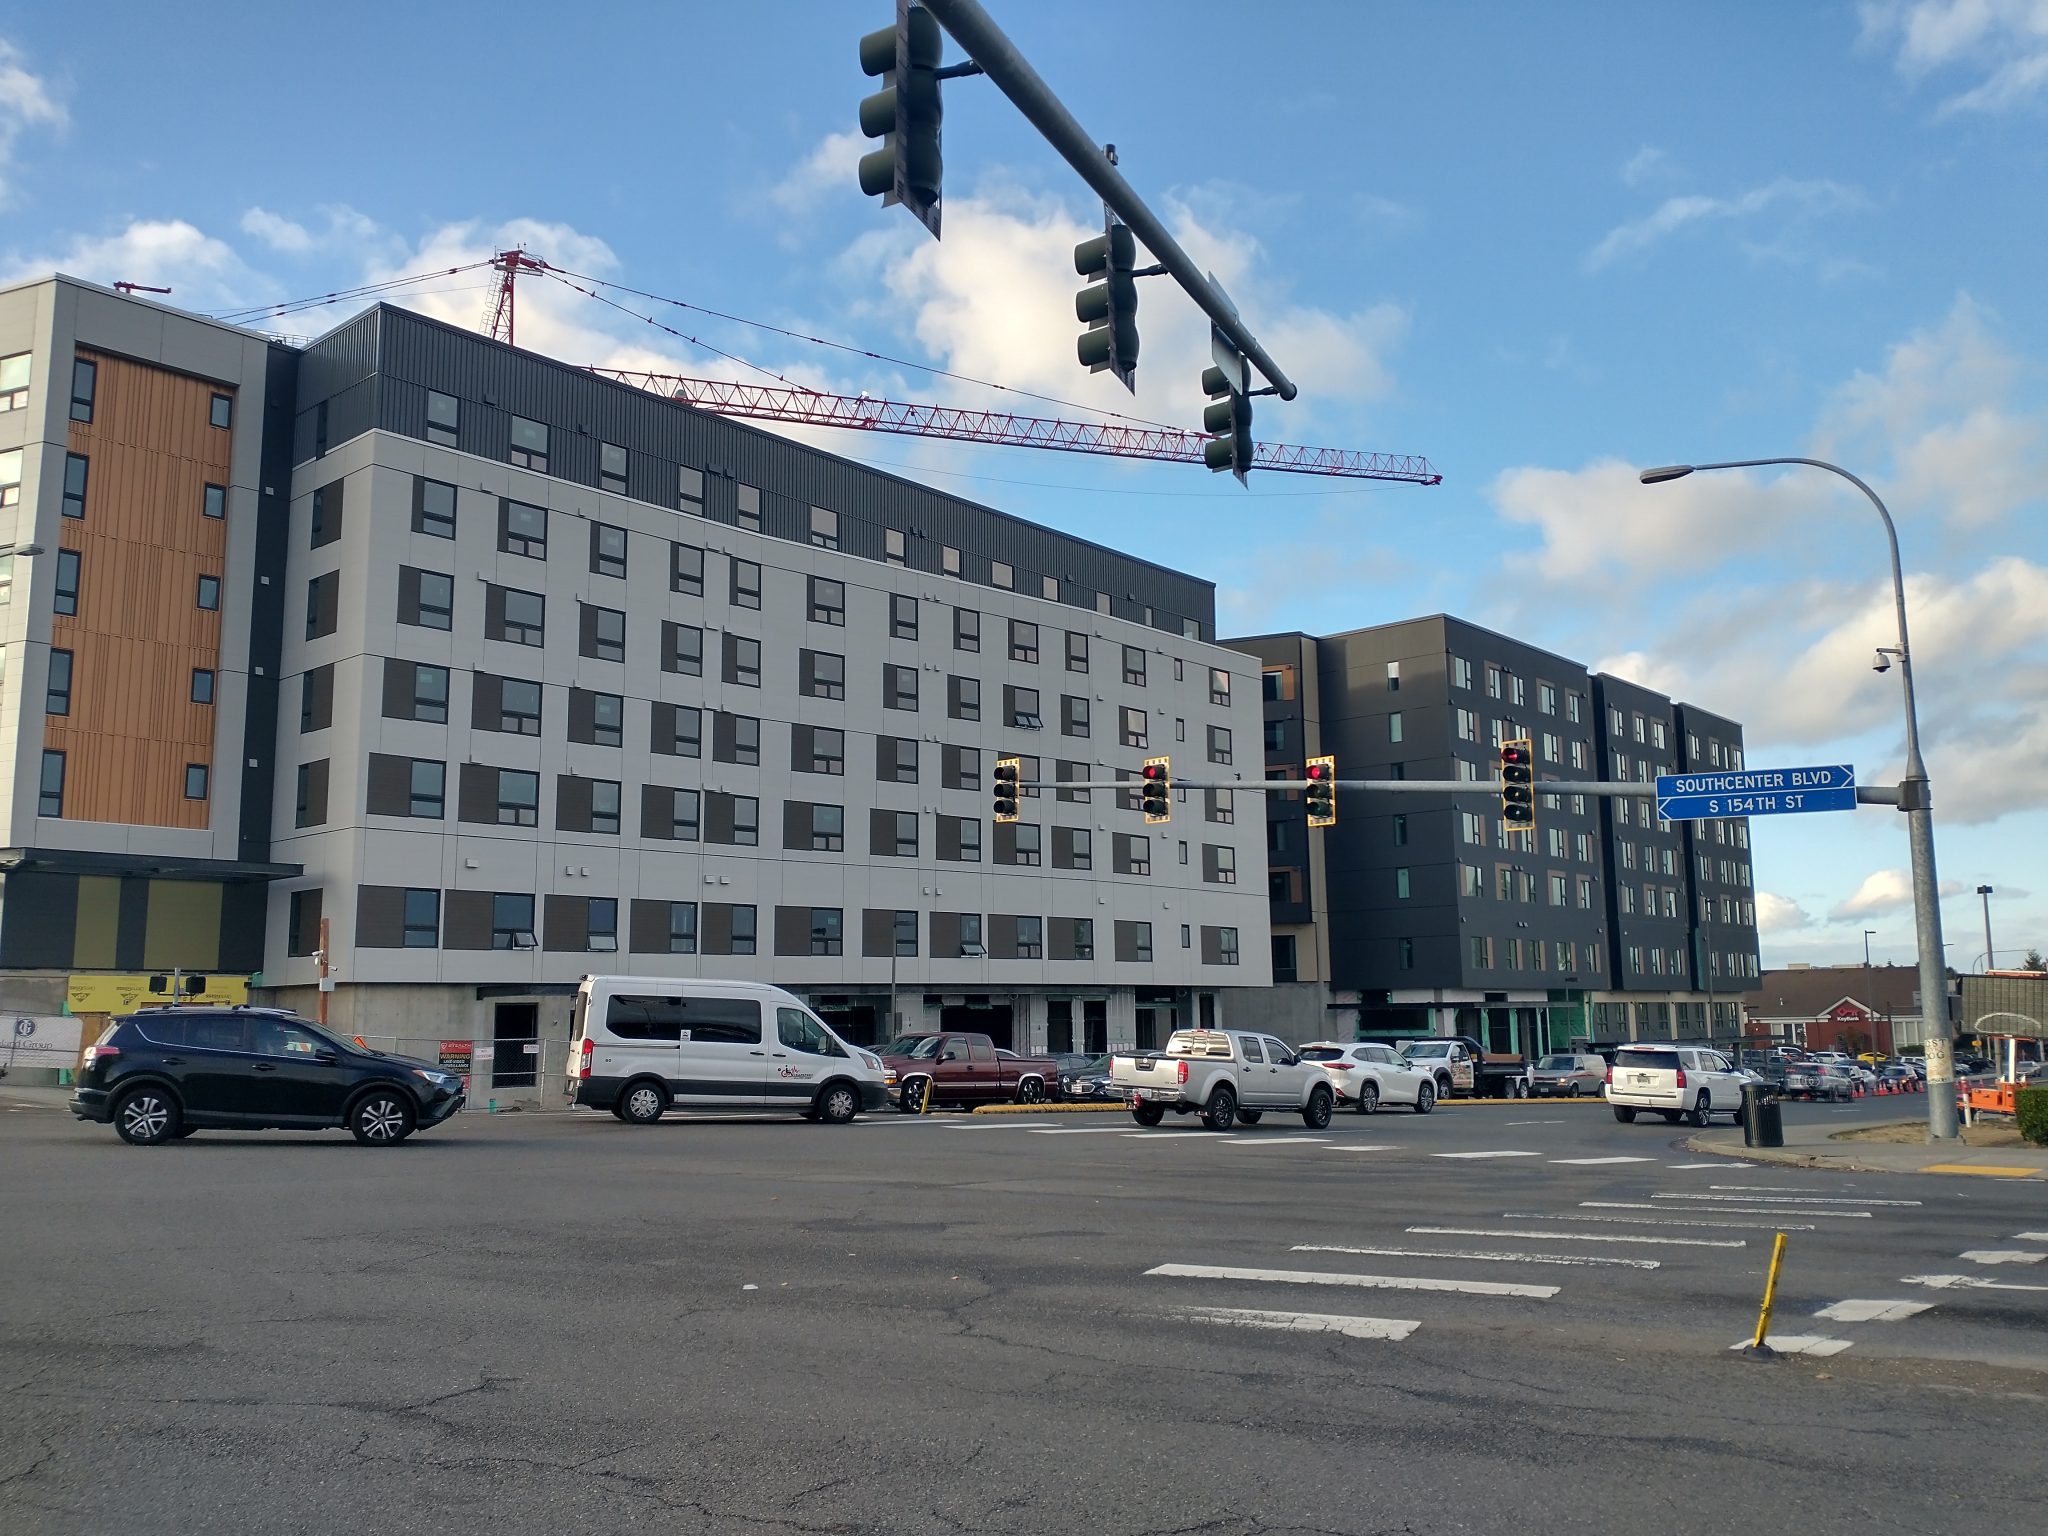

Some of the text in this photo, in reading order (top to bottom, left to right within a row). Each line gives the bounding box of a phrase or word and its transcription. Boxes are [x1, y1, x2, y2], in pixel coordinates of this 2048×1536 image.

[1675, 771, 1832, 793] SOUTHCENTER BLVD
[1709, 795, 1804, 813] S 154TH ST
[23, 1040, 53, 1049] Group
